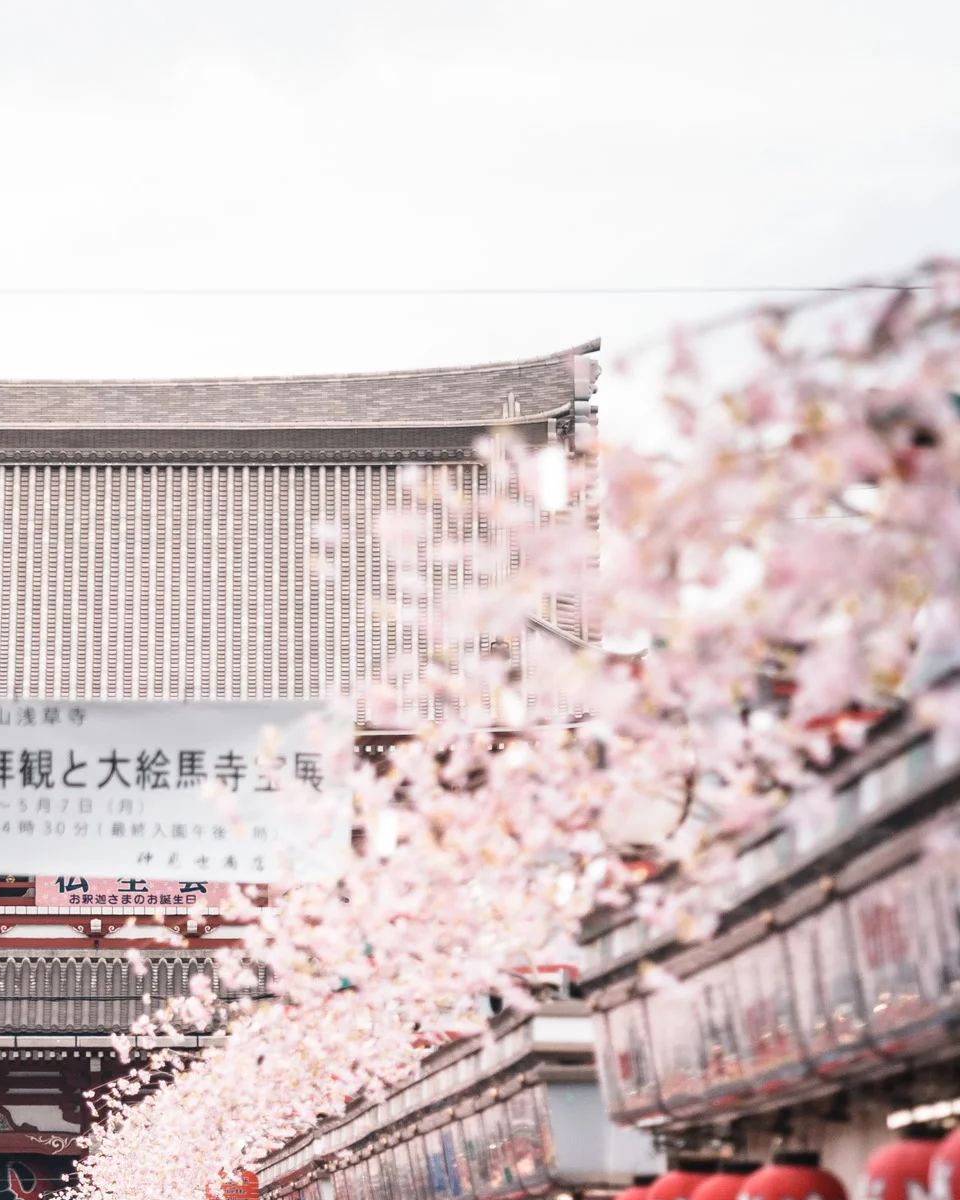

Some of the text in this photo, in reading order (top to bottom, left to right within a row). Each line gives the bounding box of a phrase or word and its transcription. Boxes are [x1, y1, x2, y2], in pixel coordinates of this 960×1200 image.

[69, 894, 197, 905] お釈迦さまのお誕生日
